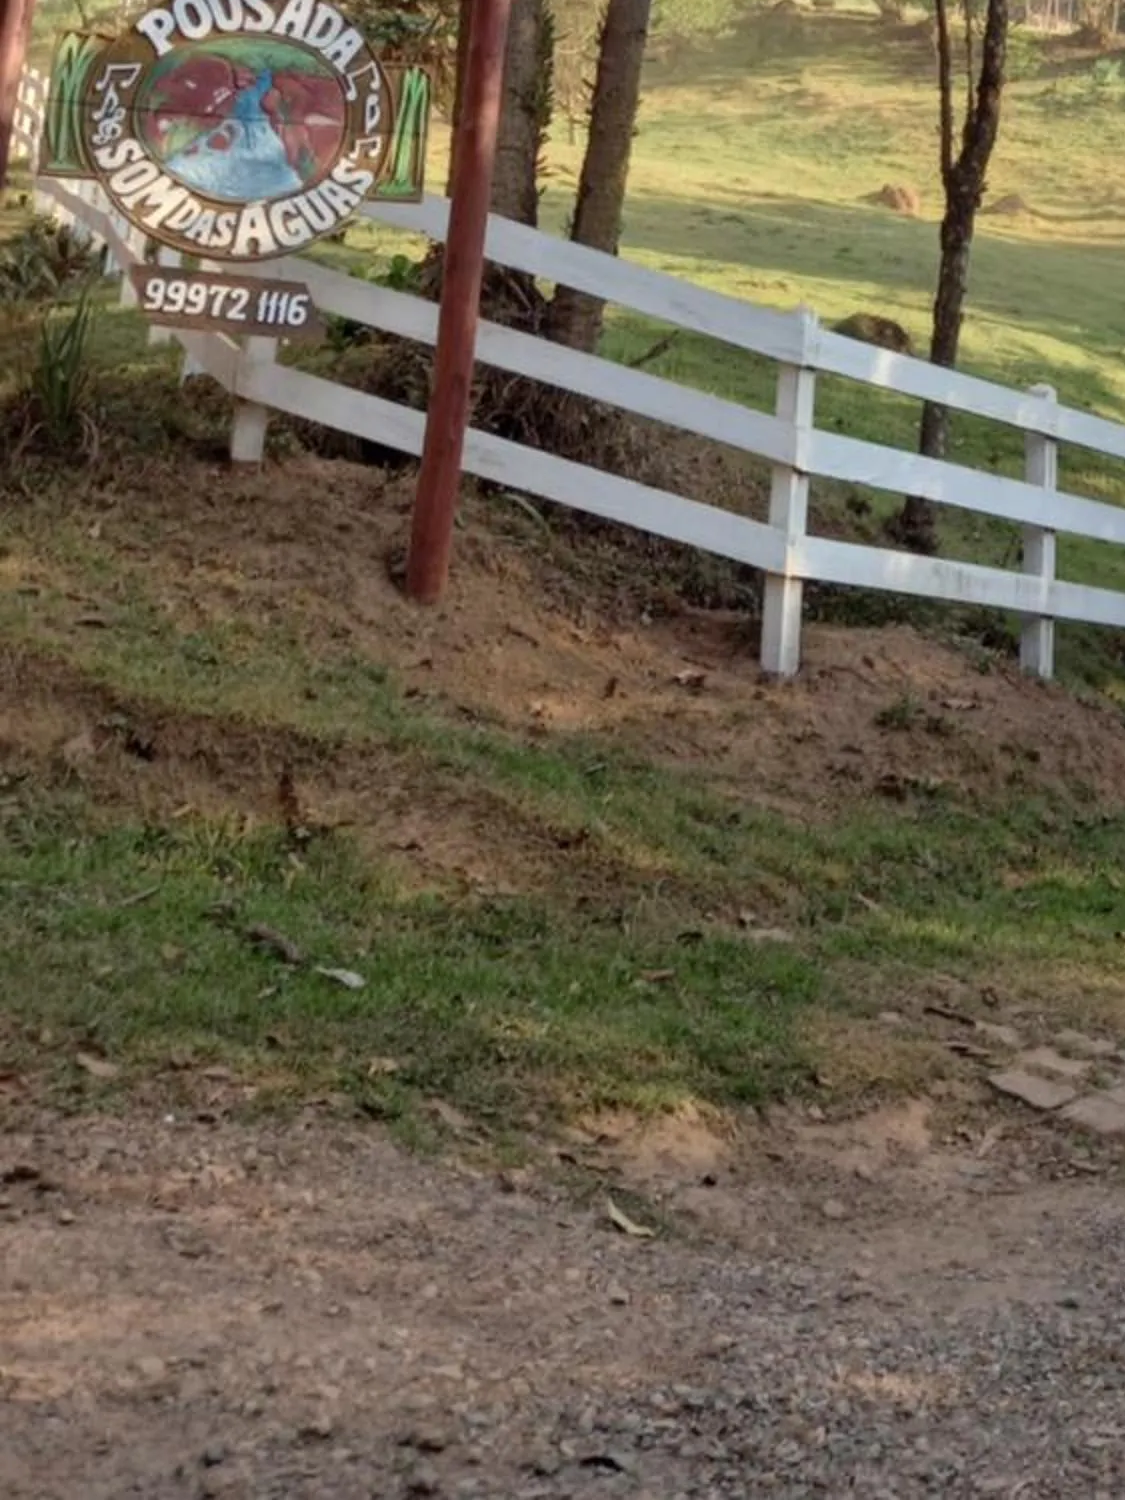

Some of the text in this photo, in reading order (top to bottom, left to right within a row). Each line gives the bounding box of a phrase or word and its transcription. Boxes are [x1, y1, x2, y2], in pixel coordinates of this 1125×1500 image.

[95, 139, 189, 229] SOM
[166, 203, 237, 247] DAS
[143, 278, 309, 326] 99972 1116
